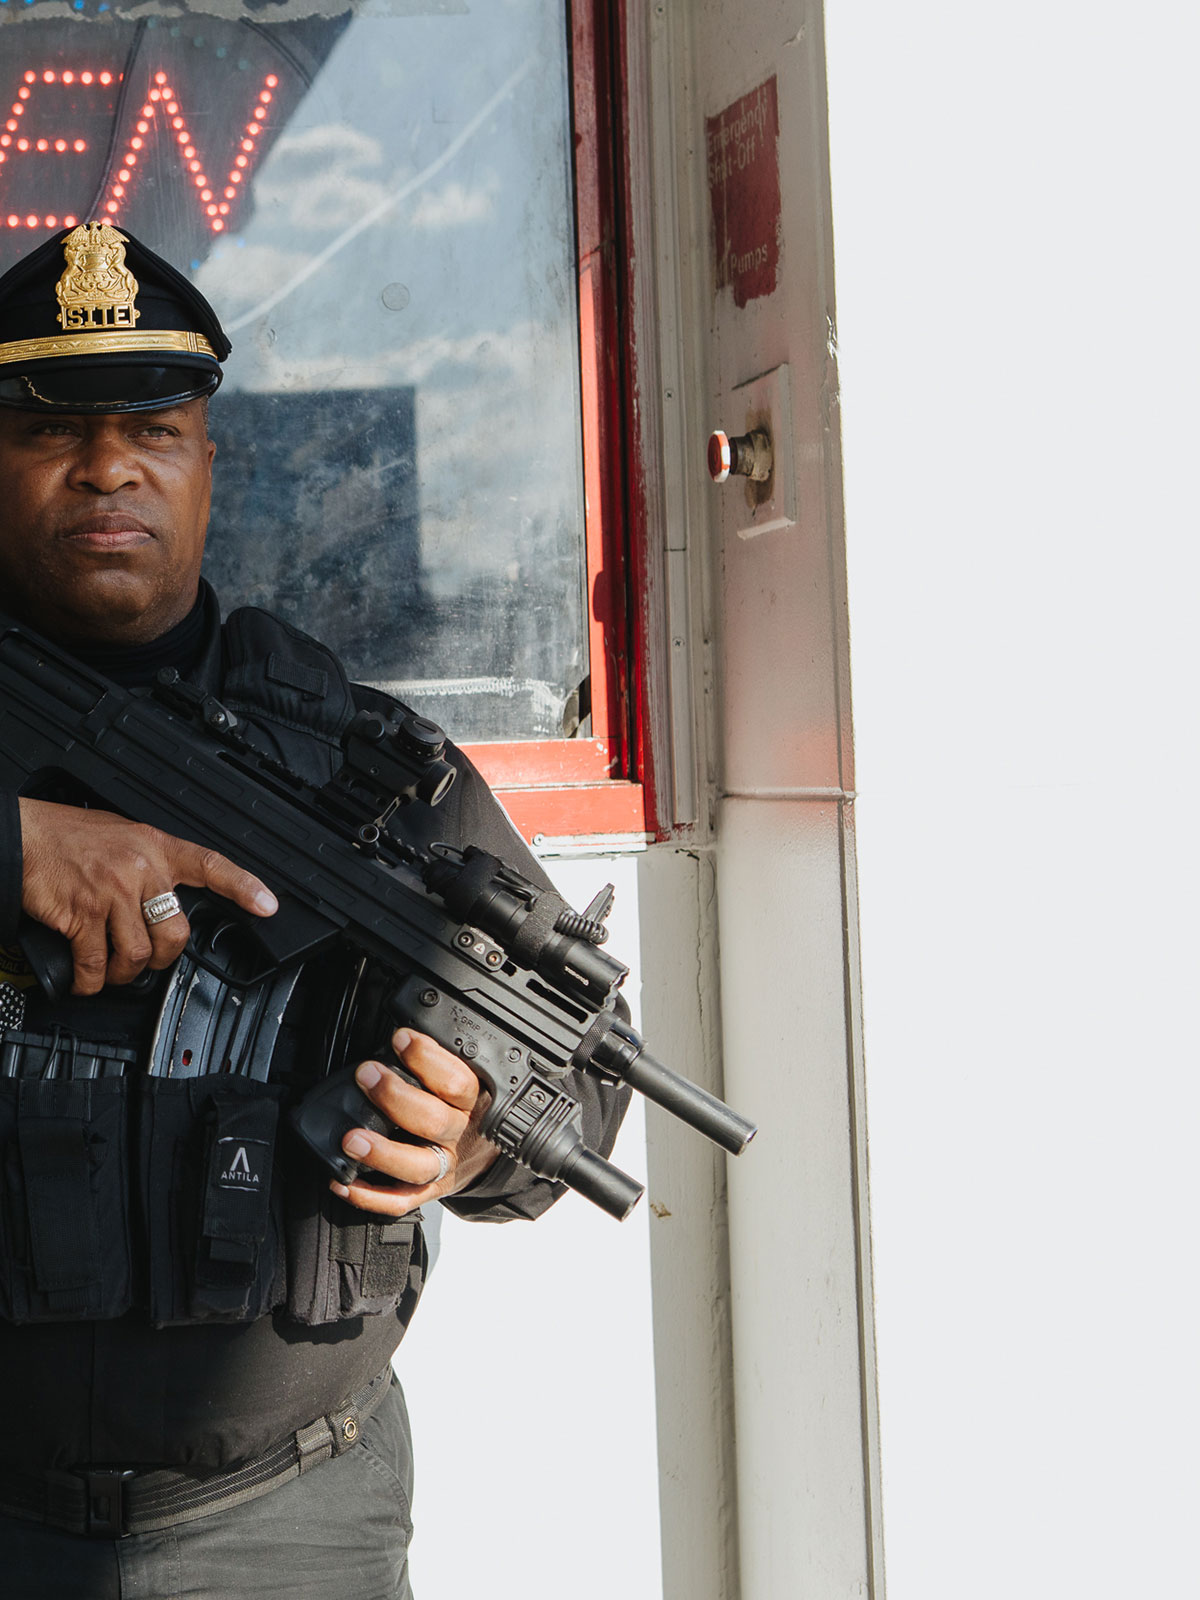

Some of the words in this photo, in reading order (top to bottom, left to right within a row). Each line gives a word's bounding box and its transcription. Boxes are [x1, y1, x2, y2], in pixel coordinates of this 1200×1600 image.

[730, 243, 768, 277] Pumps
[68, 305, 130, 326] SITE
[221, 1171, 260, 1183] ANTILA
